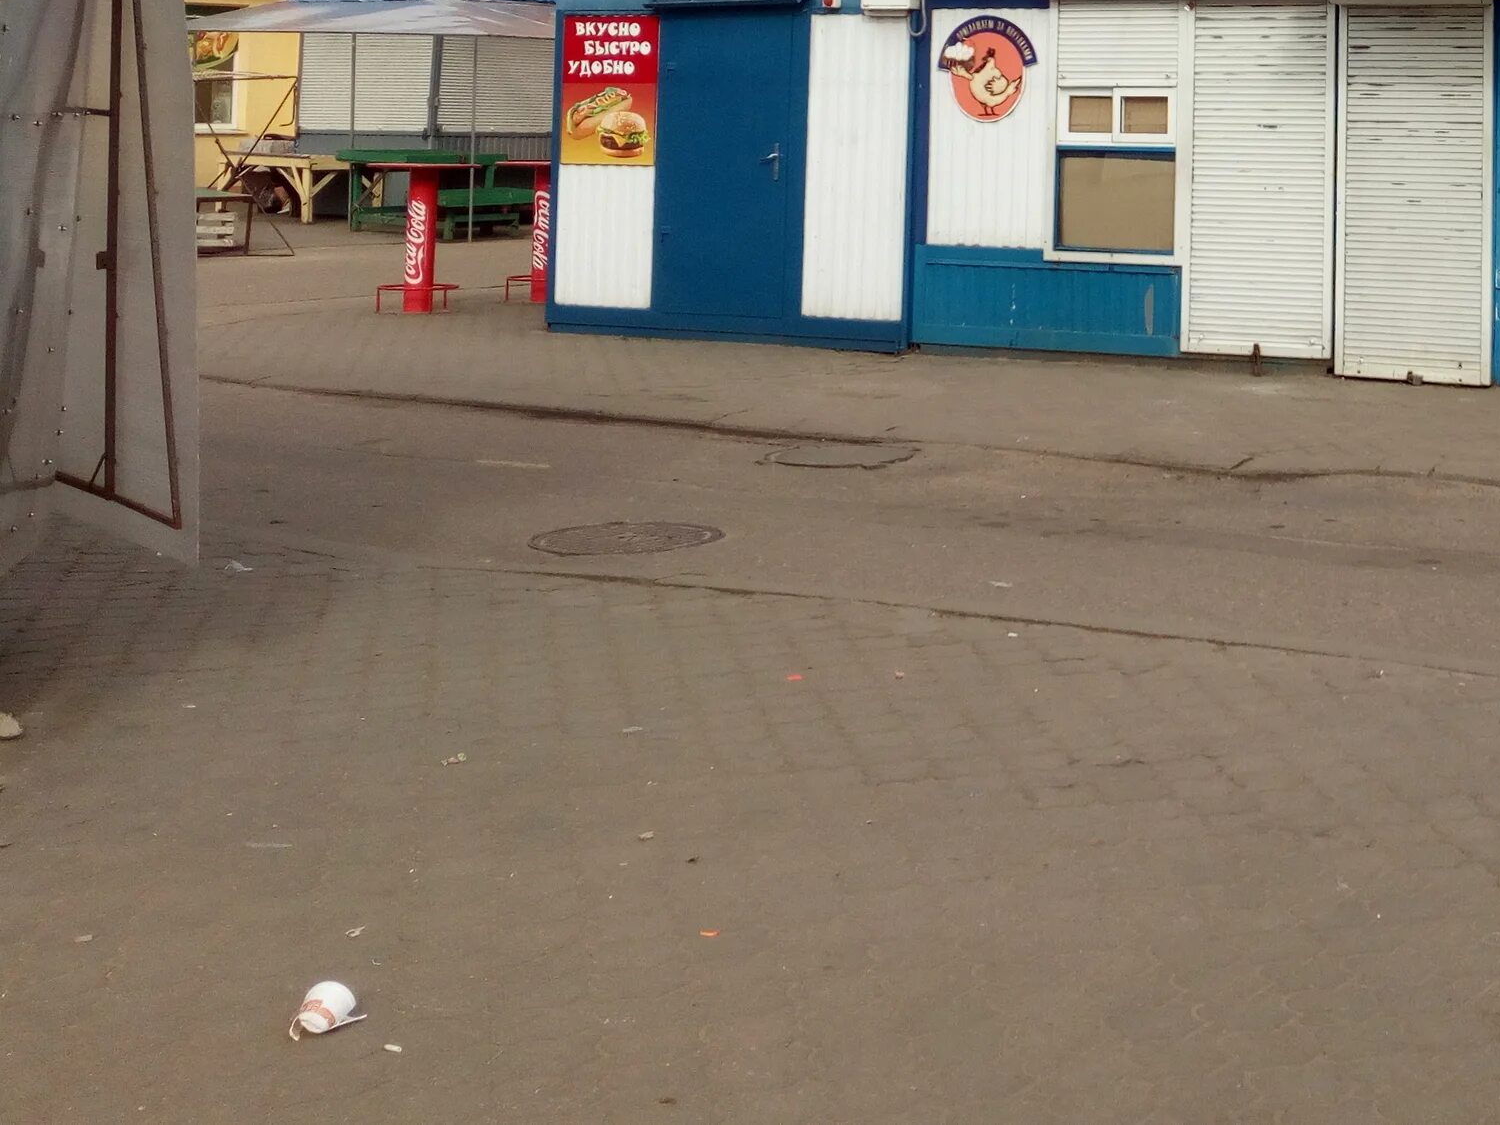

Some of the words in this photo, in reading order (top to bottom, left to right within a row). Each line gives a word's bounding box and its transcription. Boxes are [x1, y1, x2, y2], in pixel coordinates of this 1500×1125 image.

[575, 20, 641, 38] ВКУСНО
[583, 40, 652, 57] БЫСТРО
[567, 59, 635, 78] УДОБНО
